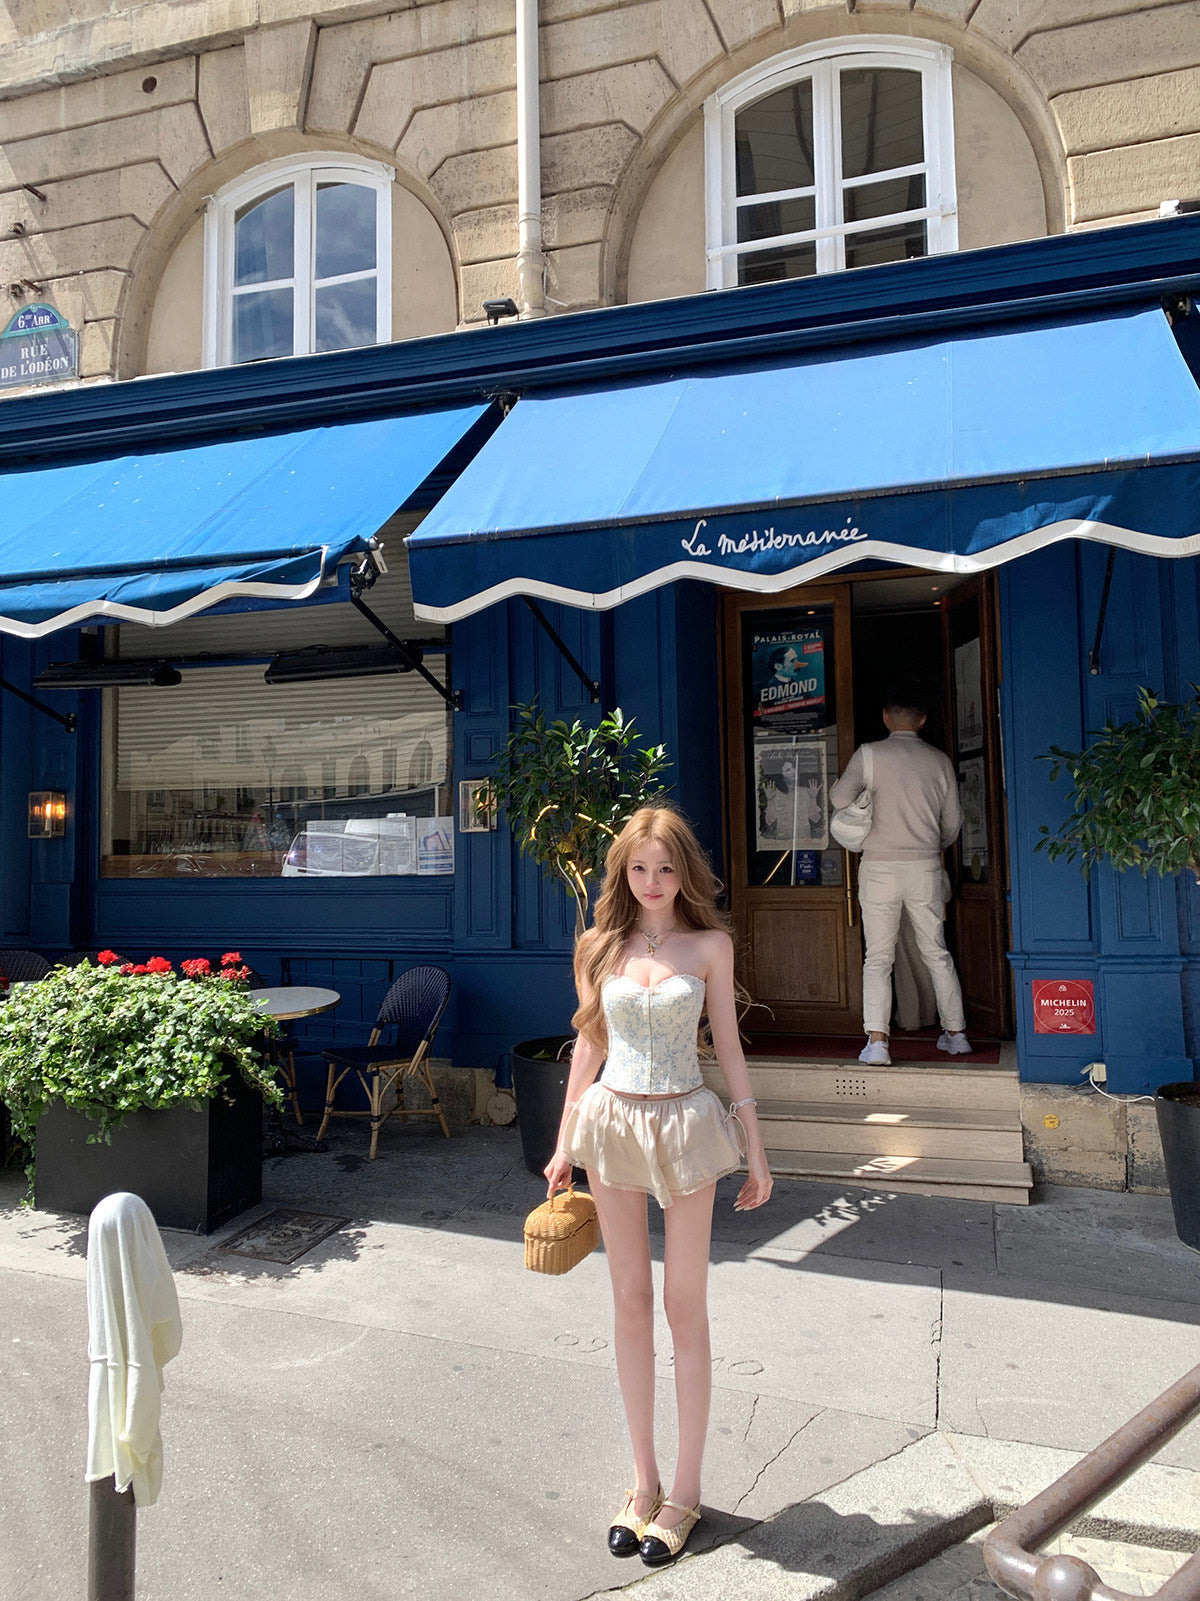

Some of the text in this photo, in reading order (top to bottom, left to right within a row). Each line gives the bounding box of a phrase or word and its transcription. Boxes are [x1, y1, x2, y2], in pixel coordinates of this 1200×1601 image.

[21, 343, 48, 360] RUE
[1, 355, 69, 379] DE L'ODÉON
[681, 519, 712, 556] La
[760, 677, 818, 703] EDMOND
[1040, 999, 1087, 1007] MICHELIN
[1054, 1008, 1075, 1016] 2025
